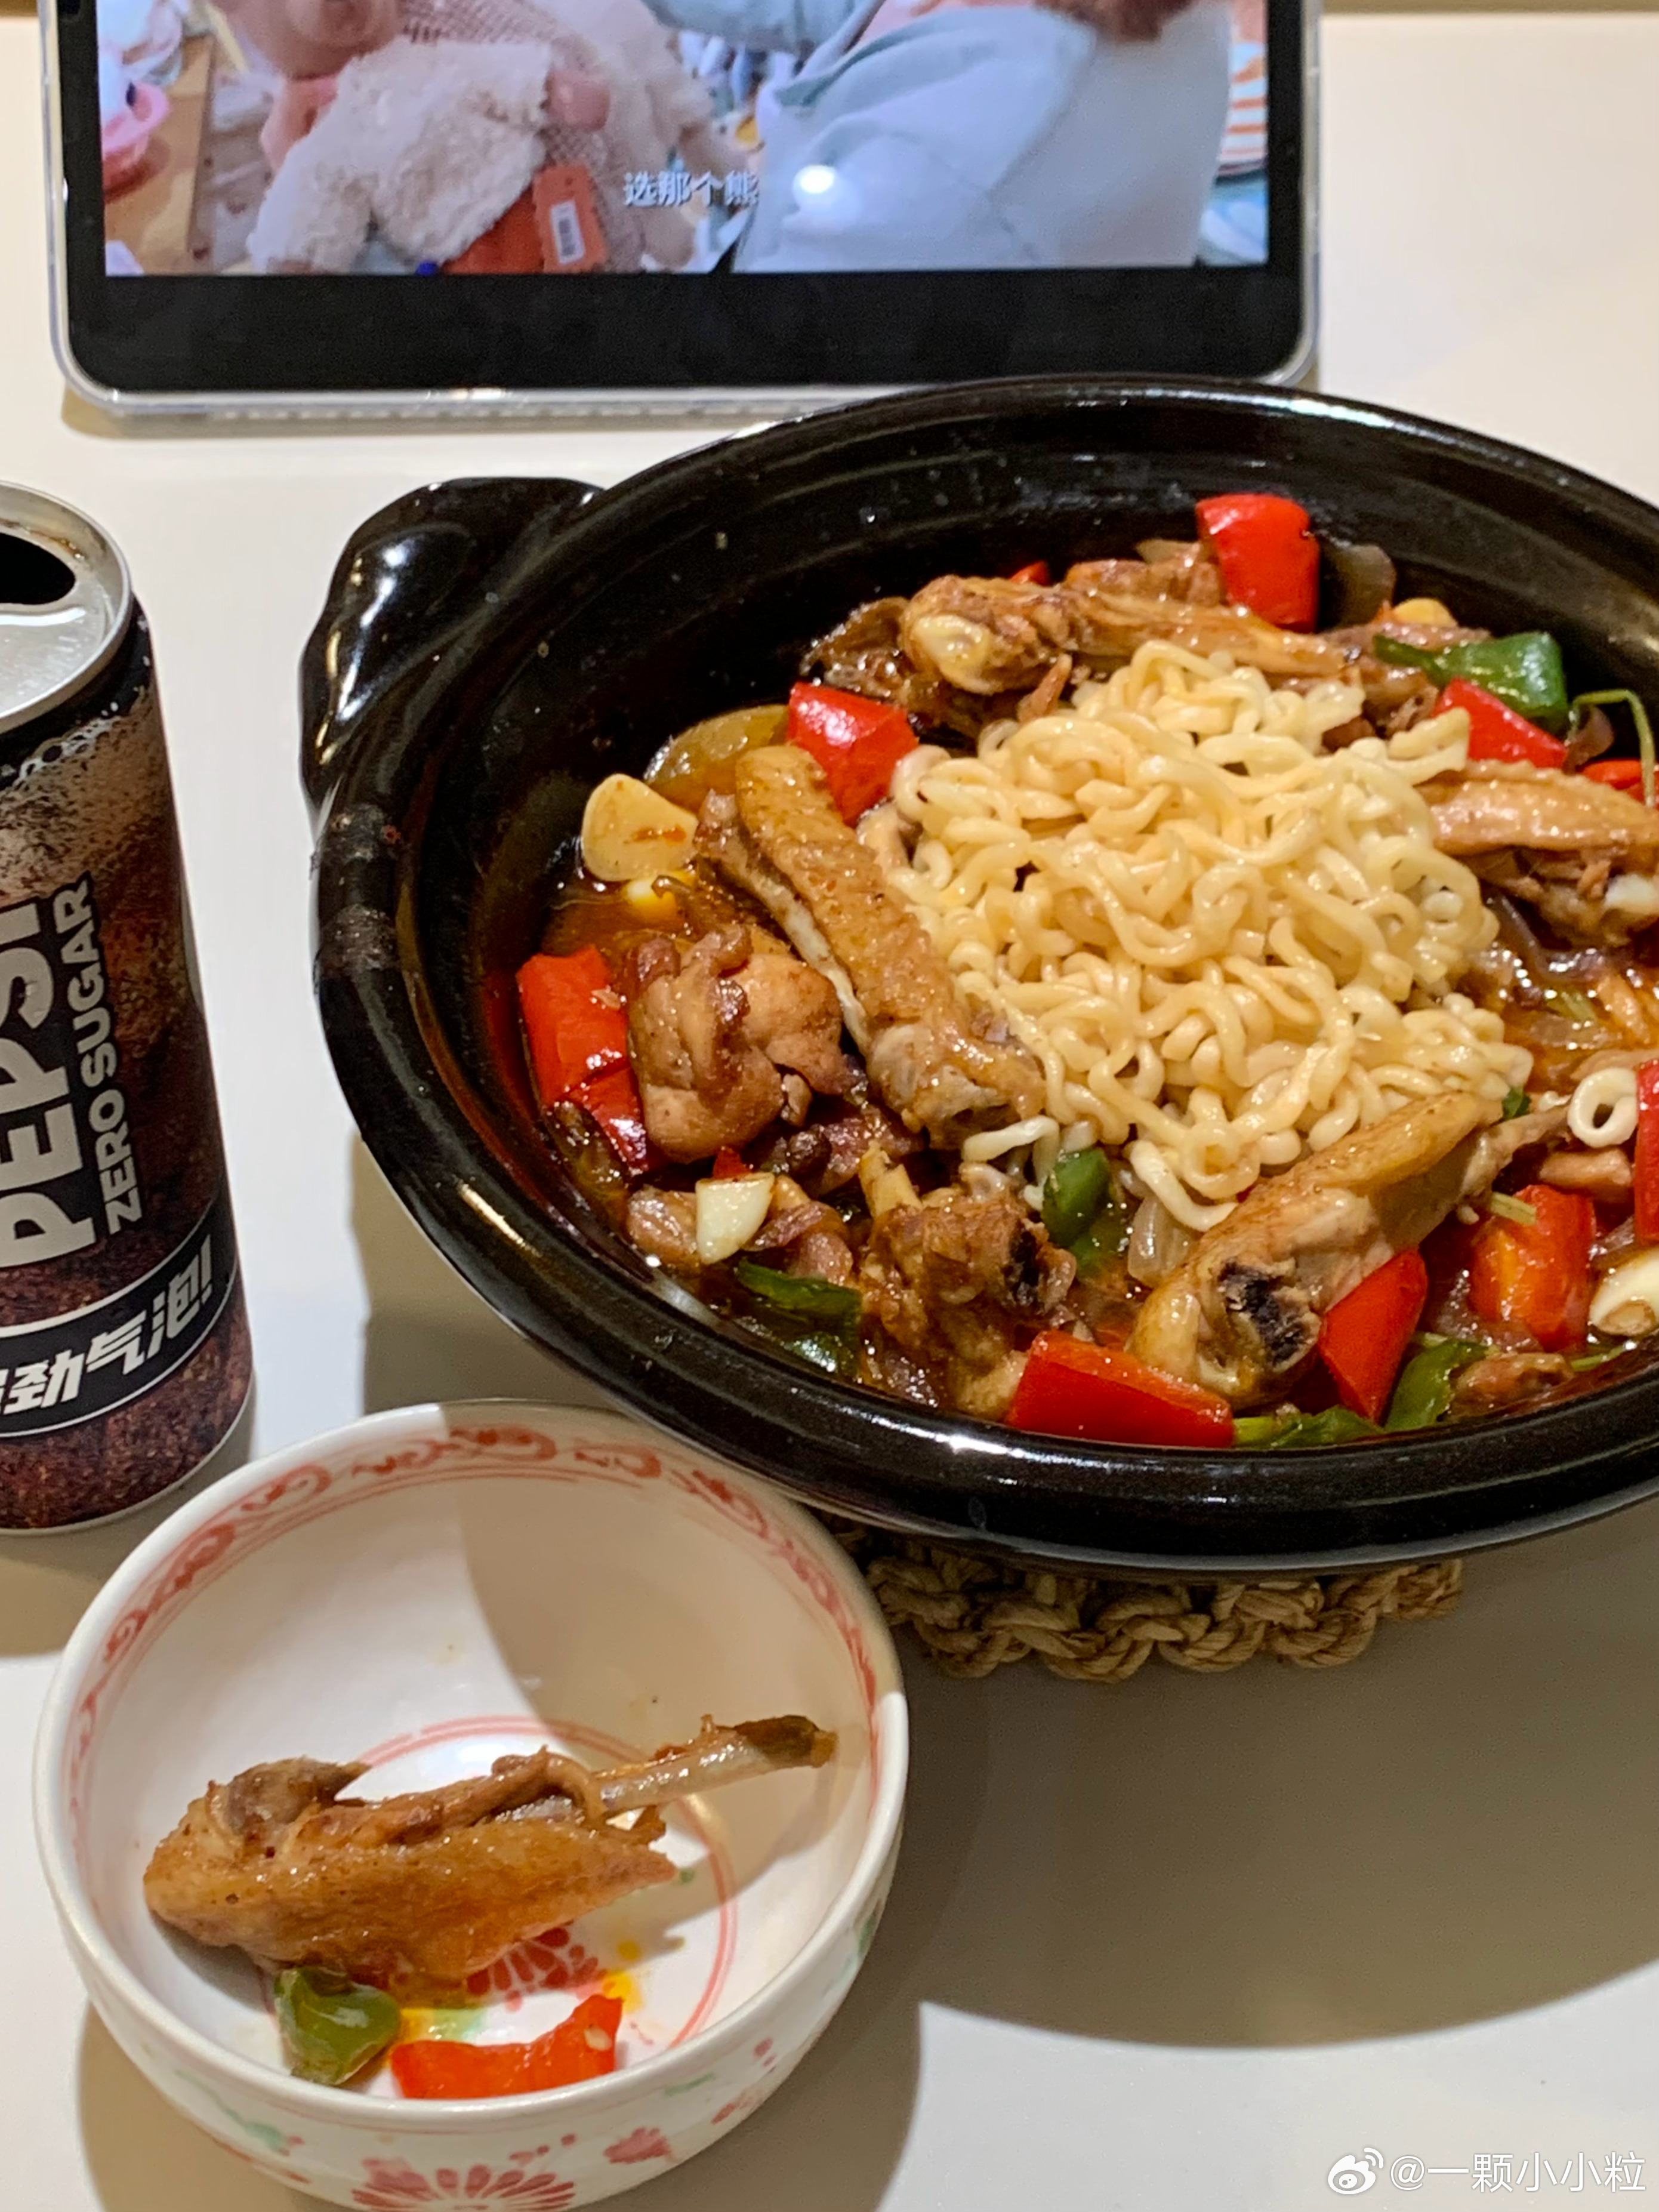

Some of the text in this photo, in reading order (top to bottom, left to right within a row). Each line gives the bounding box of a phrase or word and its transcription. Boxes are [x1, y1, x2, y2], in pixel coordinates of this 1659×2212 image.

[623, 170, 759, 207] 选那个熊
[53, 879, 143, 1234] ZERO SUGAR
[0, 1234, 212, 1417] 劲气泡!
